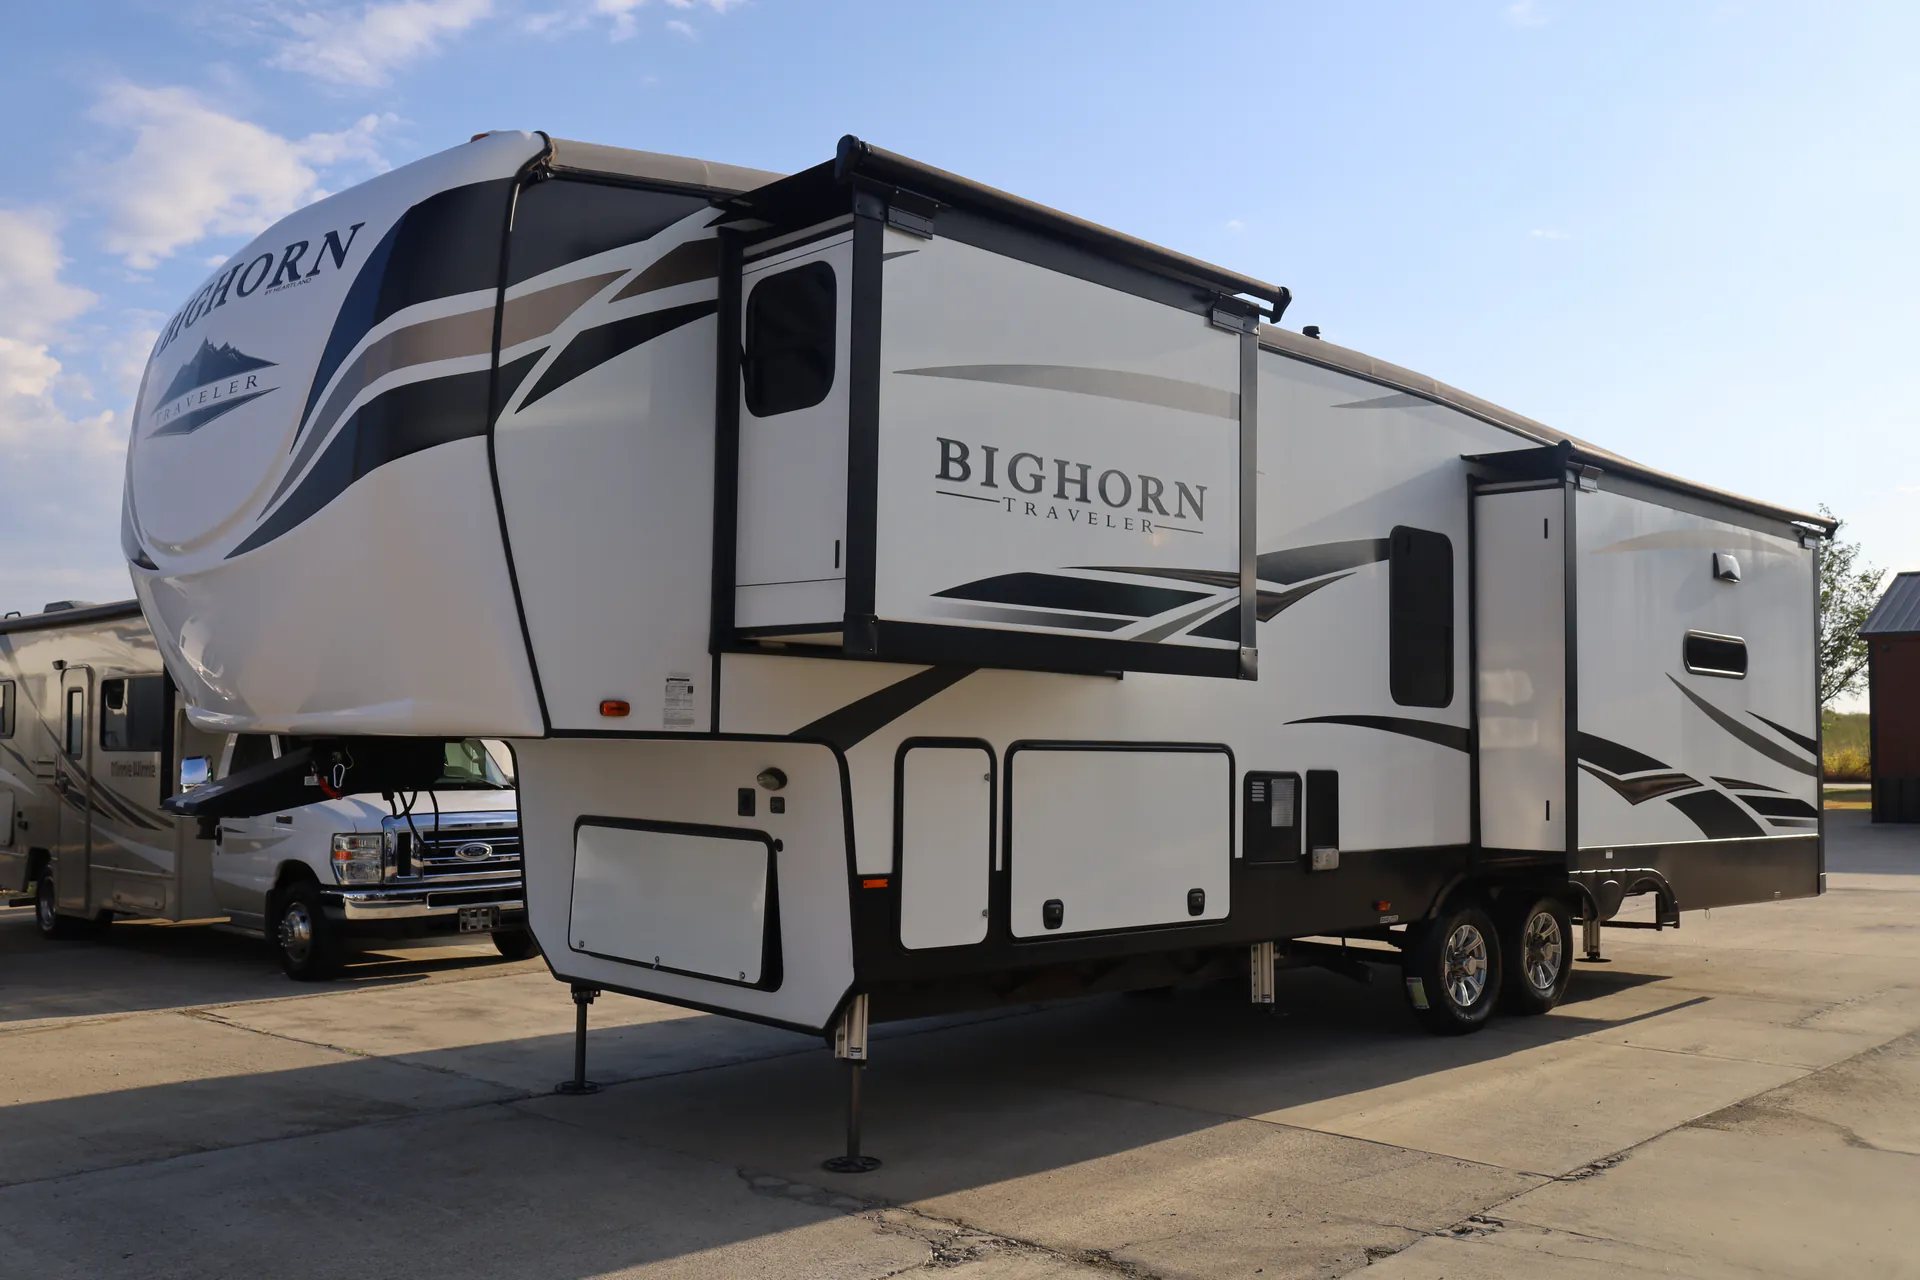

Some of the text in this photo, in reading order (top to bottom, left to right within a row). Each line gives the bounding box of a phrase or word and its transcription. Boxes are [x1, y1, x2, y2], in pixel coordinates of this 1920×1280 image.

[157, 222, 365, 357] BIGHORN
[155, 374, 258, 427] TRAVELER
[935, 437, 1208, 522] BIGHORN
[1002, 496, 1154, 534] TRAVELER
